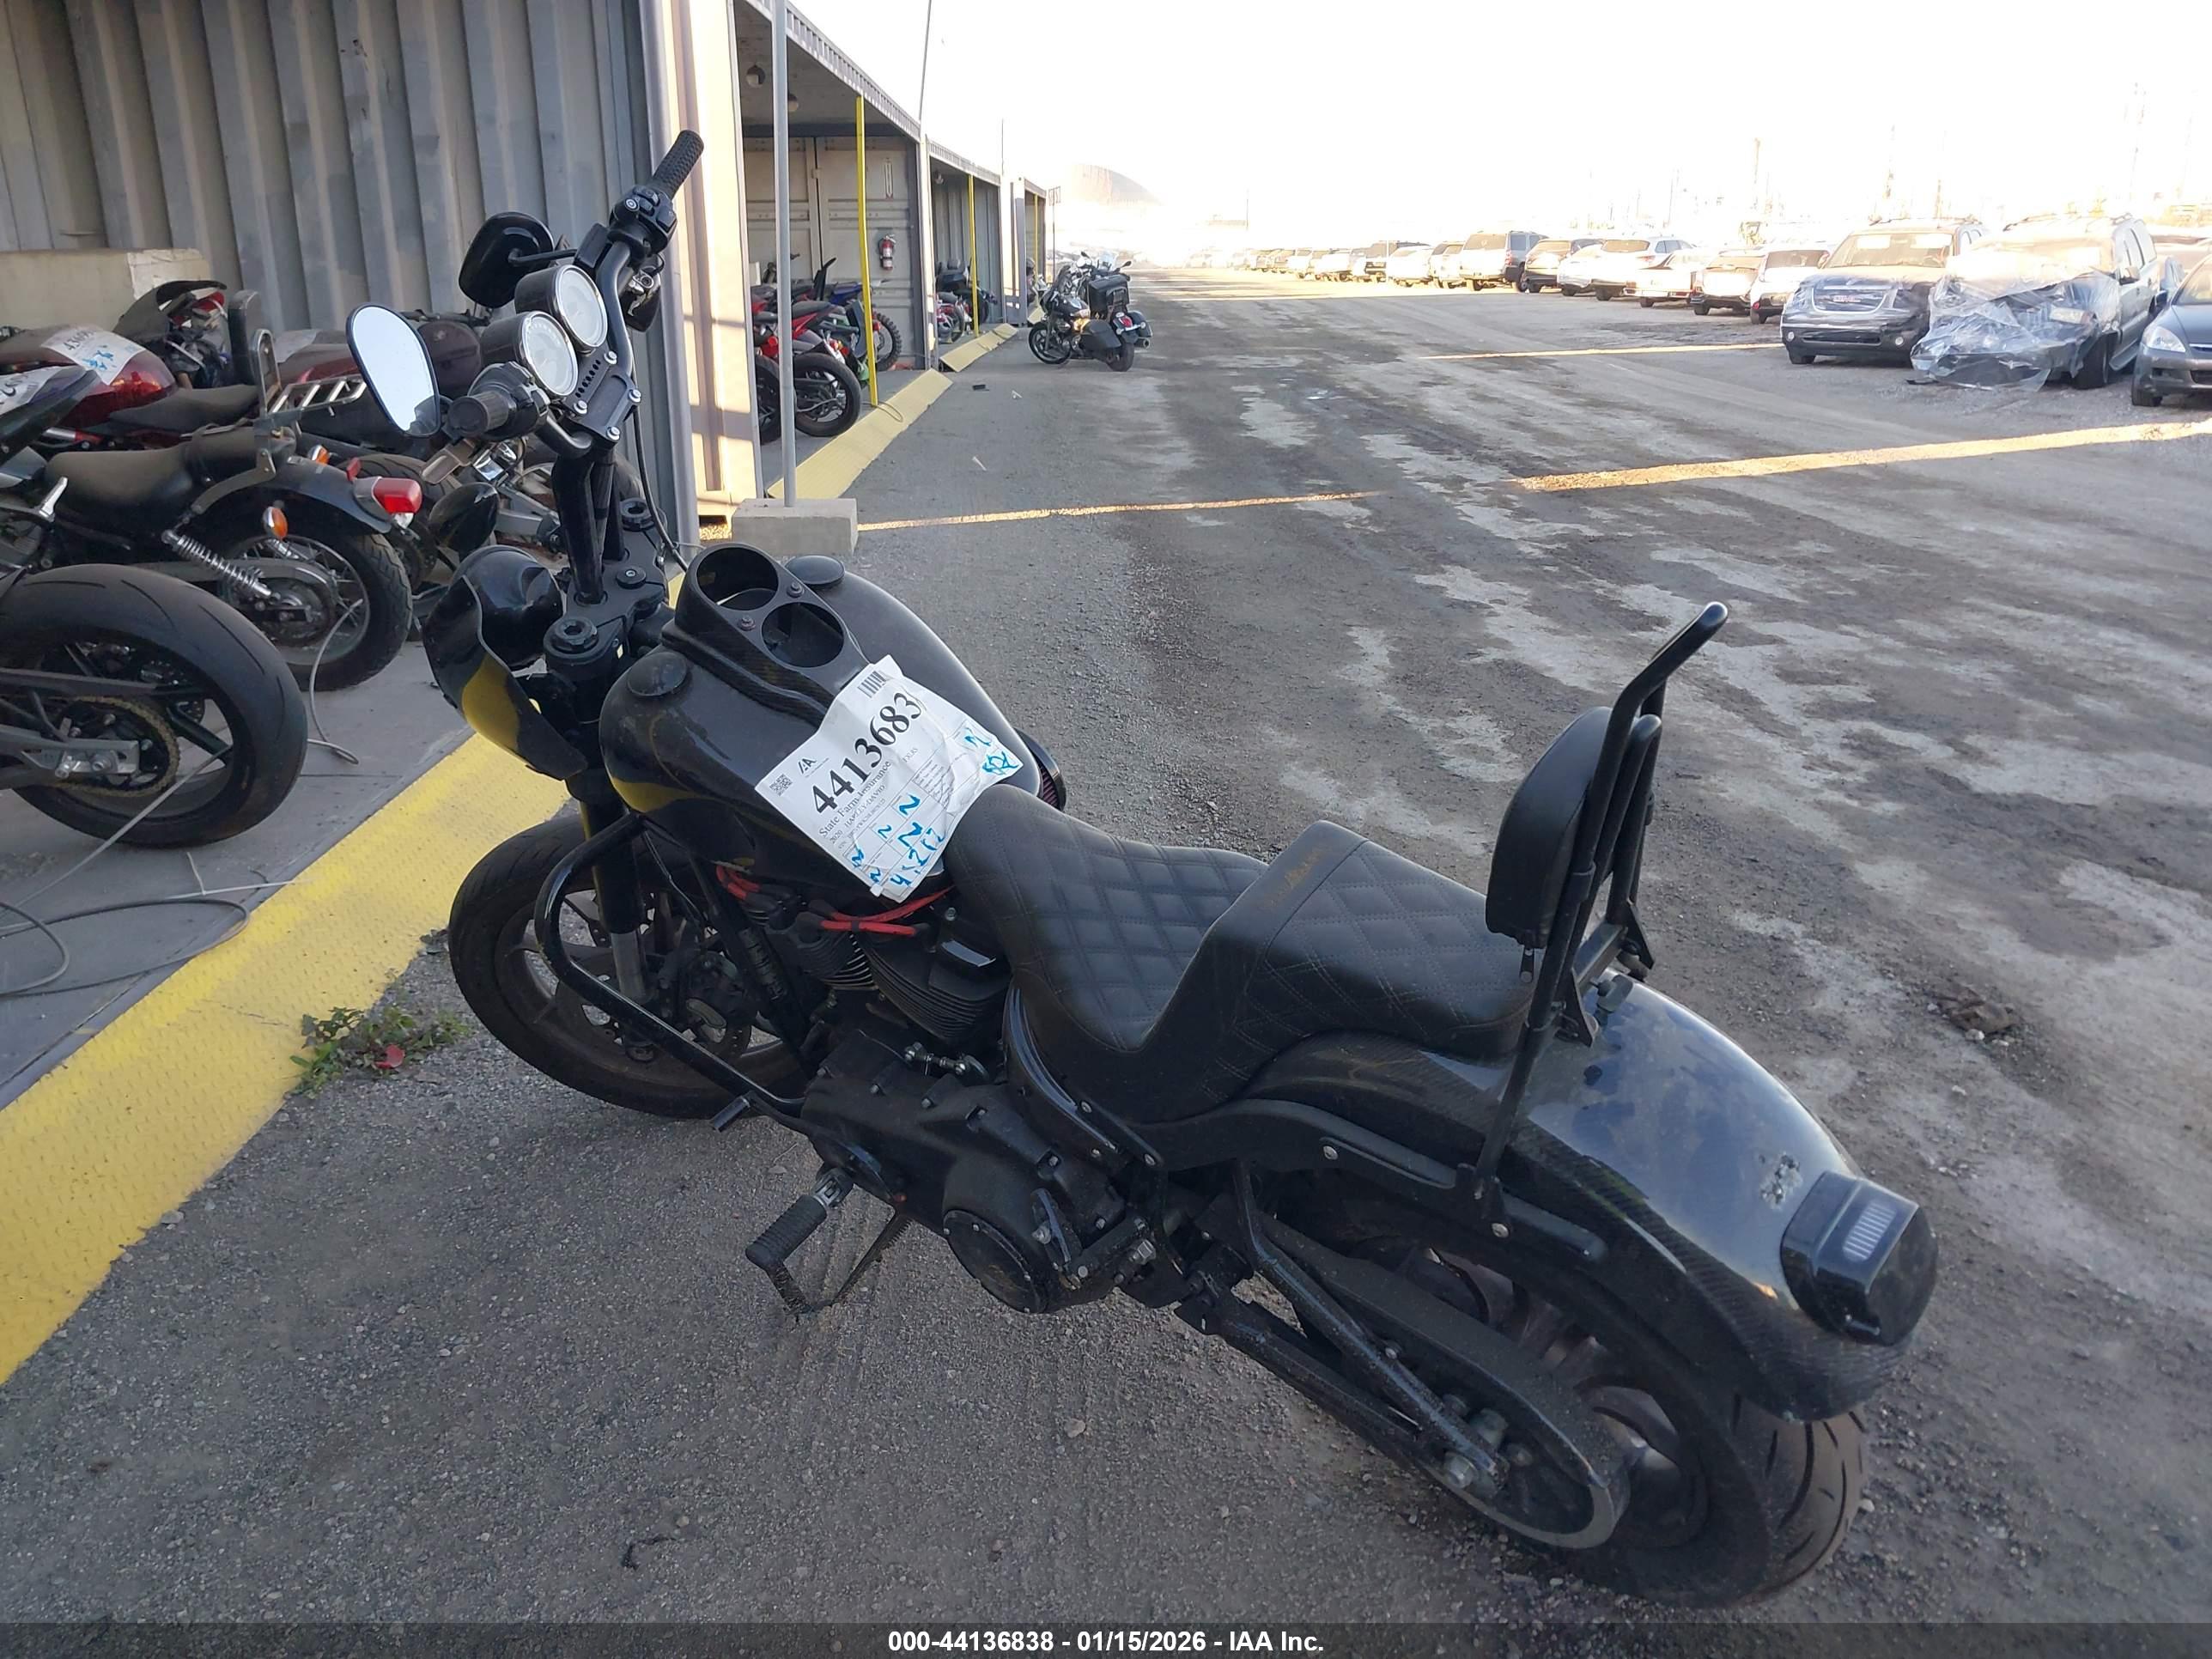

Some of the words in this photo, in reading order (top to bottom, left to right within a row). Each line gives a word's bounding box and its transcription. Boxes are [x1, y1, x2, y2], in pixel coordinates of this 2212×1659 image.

[811, 686, 927, 815] 4413683
[819, 816, 840, 838] State
[838, 797, 859, 817] Farm
[857, 761, 891, 797] Insurance
